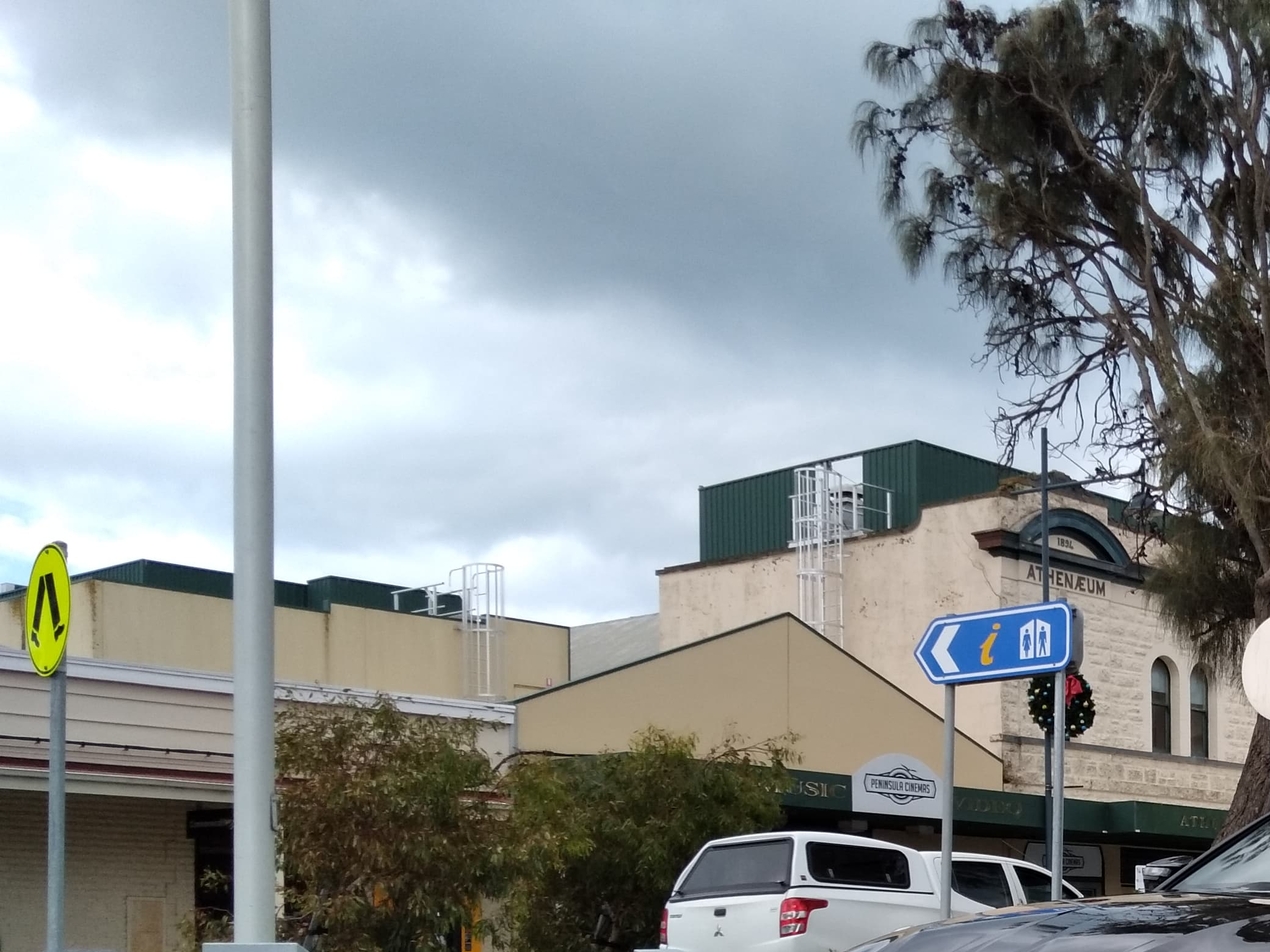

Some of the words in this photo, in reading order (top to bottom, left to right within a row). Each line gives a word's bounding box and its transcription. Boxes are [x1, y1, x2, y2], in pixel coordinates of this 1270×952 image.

[1057, 537, 1074, 550] 1894
[871, 778, 903, 792] PENINSULA
[905, 781, 930, 794] CINEMAS
